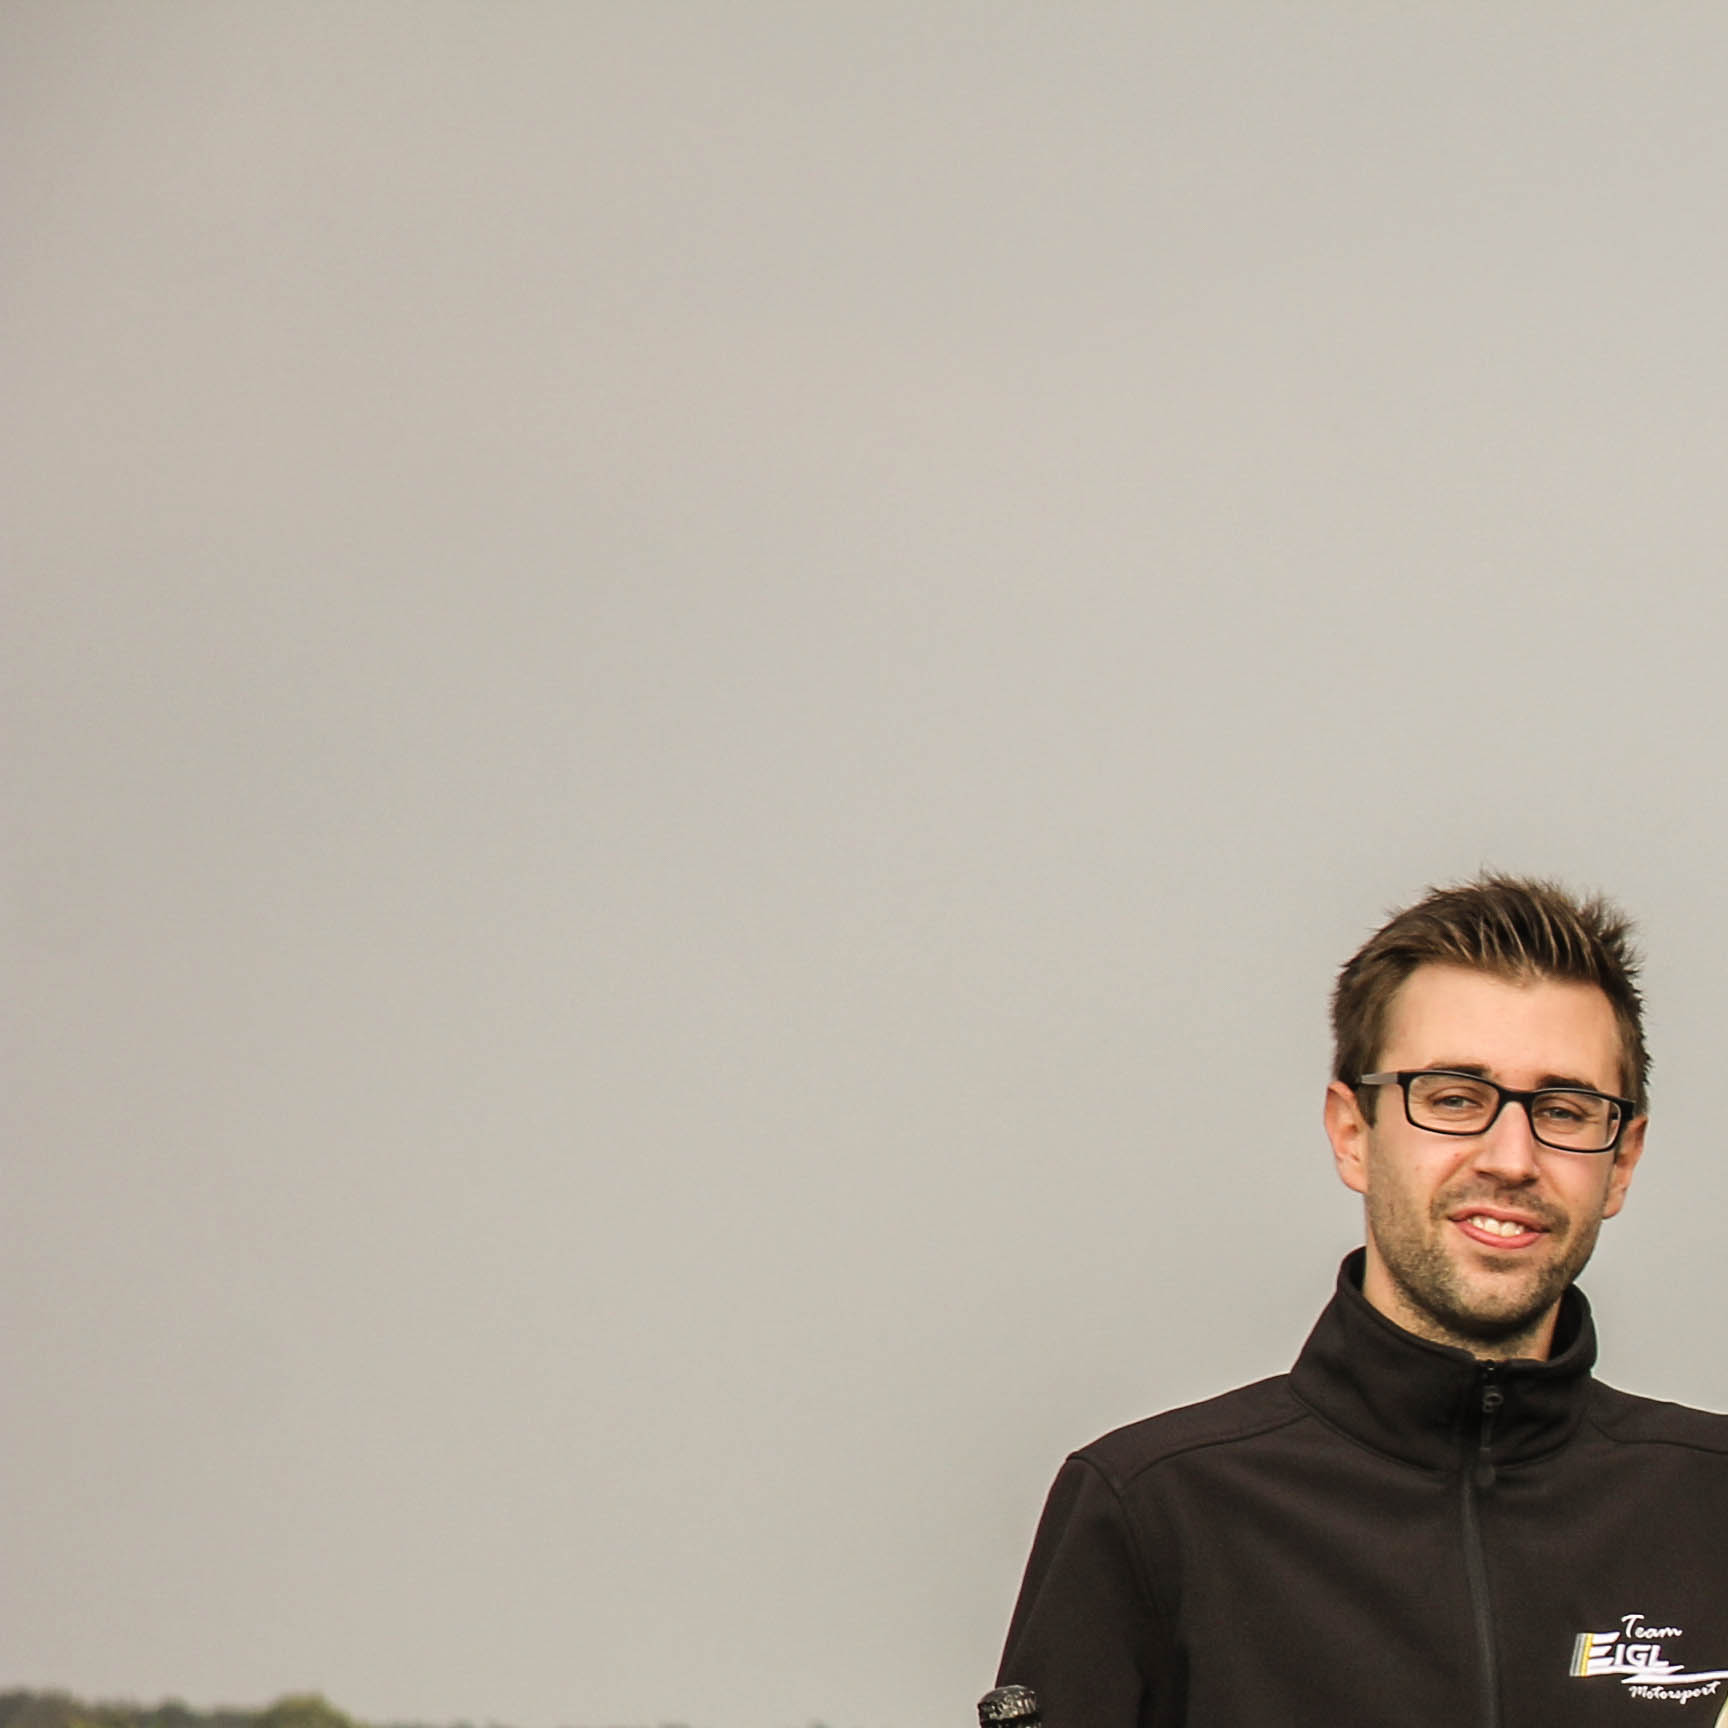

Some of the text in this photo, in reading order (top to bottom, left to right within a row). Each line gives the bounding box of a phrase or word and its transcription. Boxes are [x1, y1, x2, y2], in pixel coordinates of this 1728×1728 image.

[1621, 1613, 1683, 1639] Team
[1570, 1632, 1670, 1677] EIGL
[1628, 1680, 1721, 1704] Motorsport
